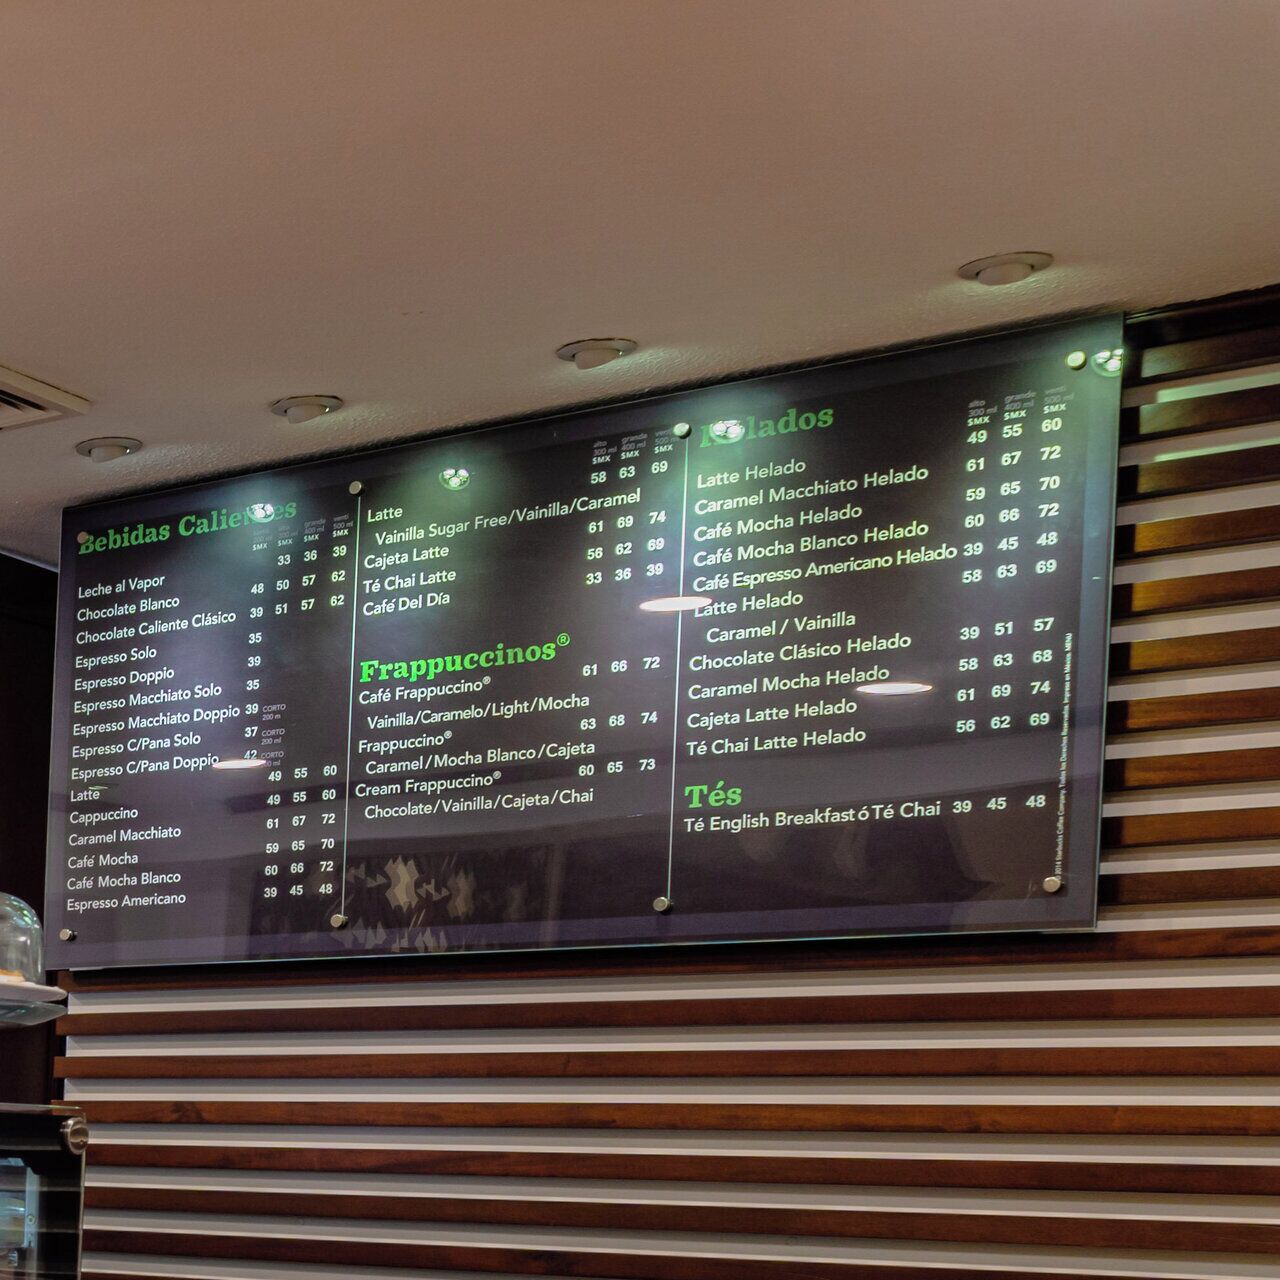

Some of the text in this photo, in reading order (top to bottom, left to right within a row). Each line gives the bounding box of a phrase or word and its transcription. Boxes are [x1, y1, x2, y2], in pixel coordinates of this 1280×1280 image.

[967, 417, 1062, 444] 49 55 60
[590, 460, 668, 484] 58 63 69
[697, 458, 806, 489] Latte Helado
[694, 465, 929, 515] Caramel Macchiato Helado
[367, 507, 403, 522] Latte
[77, 524, 170, 554] Bebidas
[375, 526, 425, 545] Vainilla
[428, 521, 470, 538] Sugar
[693, 520, 929, 567] Café Mocha Blanco Helado
[277, 545, 347, 566] 33 36 39
[364, 546, 449, 570] Cajeta Latte
[692, 543, 958, 592] Café Espresso Americano Helado
[78, 576, 166, 599] Leche al Vapor
[250, 570, 346, 594] 48 50 57 62
[362, 570, 456, 594] Té Chai Latte
[77, 597, 180, 622] Chocolate Blanco
[363, 592, 450, 616] Café Del Día
[694, 590, 803, 618] Latte Helado
[76, 611, 236, 644] Chocolate Caliente Clásico
[706, 611, 856, 643] Caramel Vainilla
[76, 645, 157, 670] Espresso Solo
[689, 632, 912, 671] Chocolate Clásico Helado
[582, 656, 660, 676] 61 66 72
[74, 666, 175, 693] Espresso Doppio
[688, 665, 890, 700] Caramel Mocha Helado
[74, 682, 222, 716] Espresso Macchiato Solo
[359, 688, 392, 704] Café
[262, 704, 286, 713] CORTO
[73, 706, 240, 738] Espresso Macchiato Doppio
[261, 728, 286, 737] CORTO
[72, 731, 201, 760] Espresso C/Pana Solo
[261, 751, 284, 759] CORTO
[72, 754, 219, 782] Espresso C/Pana Doppio
[268, 765, 337, 782] 49 55 60
[70, 790, 100, 802] Latte
[355, 784, 401, 797] Cream
[684, 780, 742, 808] Tés
[952, 794, 1046, 813] 39 45 48
[70, 807, 138, 826] Cappuccino
[683, 817, 705, 832] Té
[710, 812, 769, 833] English
[776, 801, 855, 824] Breakfast
[871, 804, 894, 820] Té
[900, 800, 941, 818] Chai
[1056, 817, 1064, 834] Coffee
[68, 826, 182, 846] Caramel Macchiato
[68, 852, 138, 869] Café Mocha
[67, 893, 186, 914] Espresso Americano
